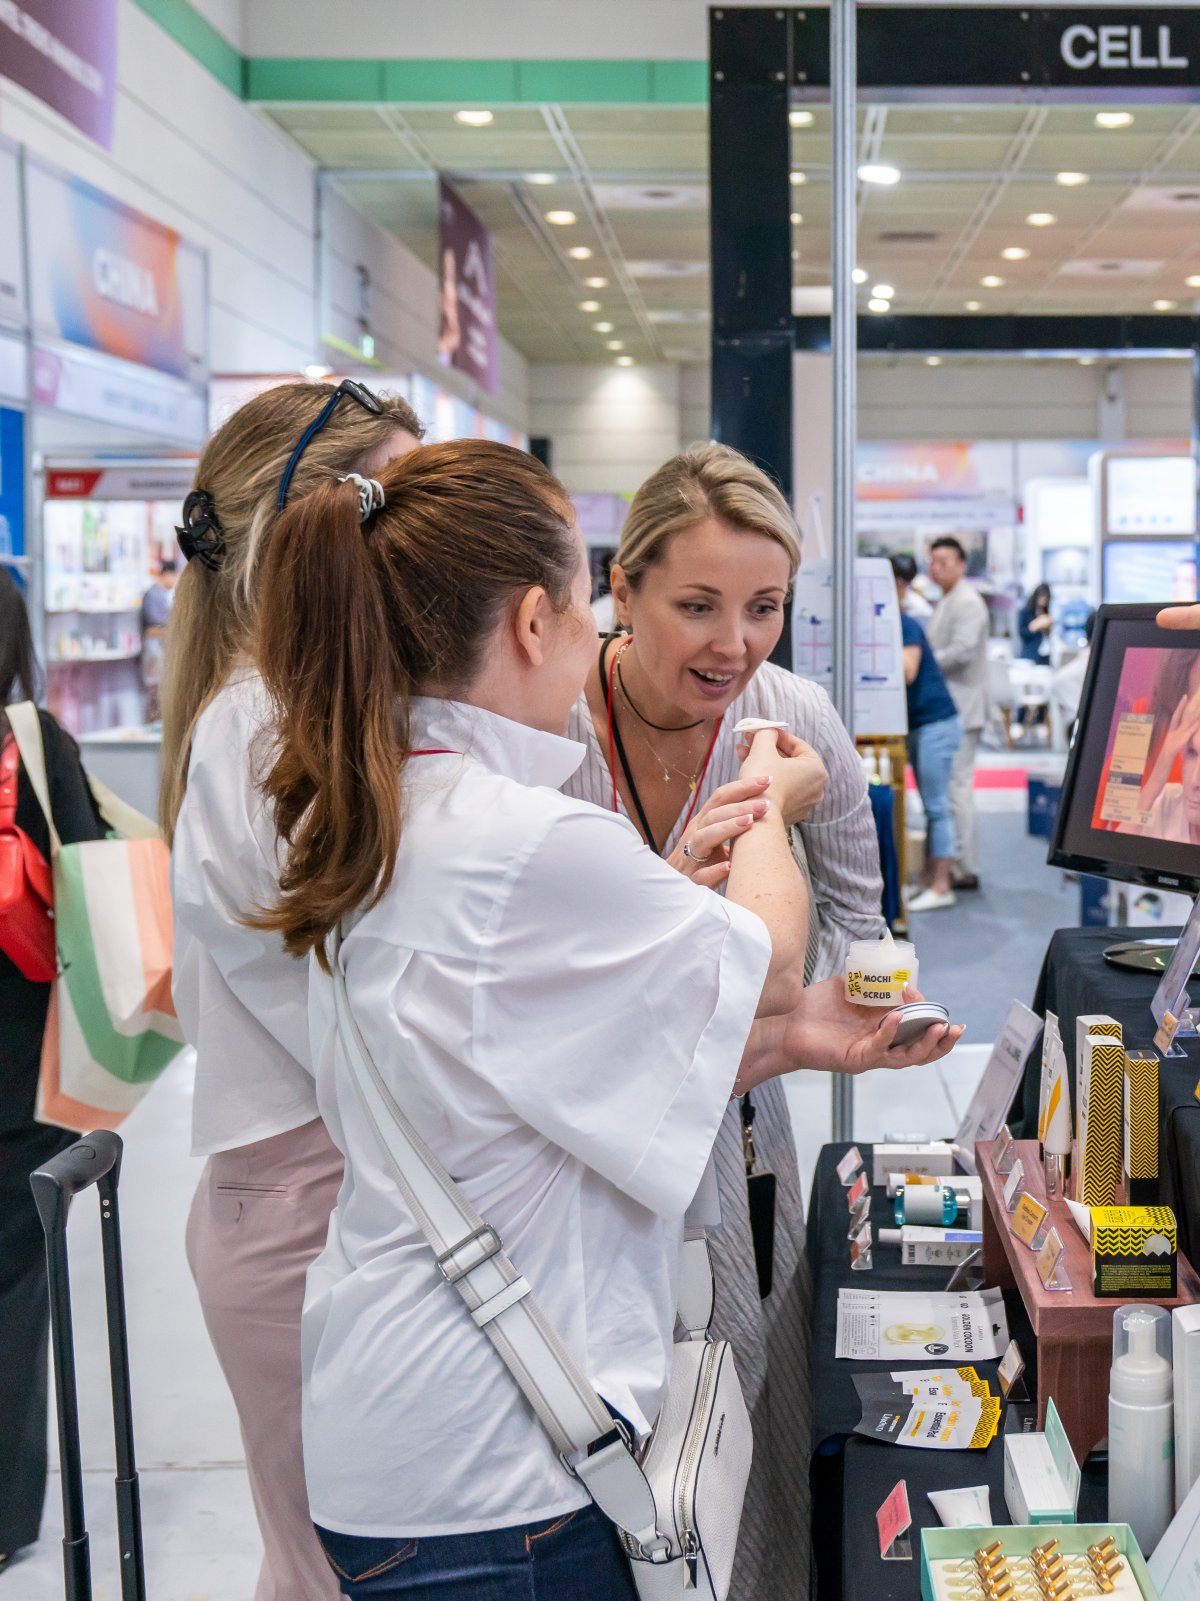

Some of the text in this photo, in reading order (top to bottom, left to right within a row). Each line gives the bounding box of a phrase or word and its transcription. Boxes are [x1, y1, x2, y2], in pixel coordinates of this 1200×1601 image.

[1060, 24, 1189, 69] CELL
[92, 246, 160, 317] CHINA
[857, 462, 939, 483] CHINA
[863, 991, 891, 999] SCRUB
[961, 1314, 974, 1352] GOLDEN COCOON
